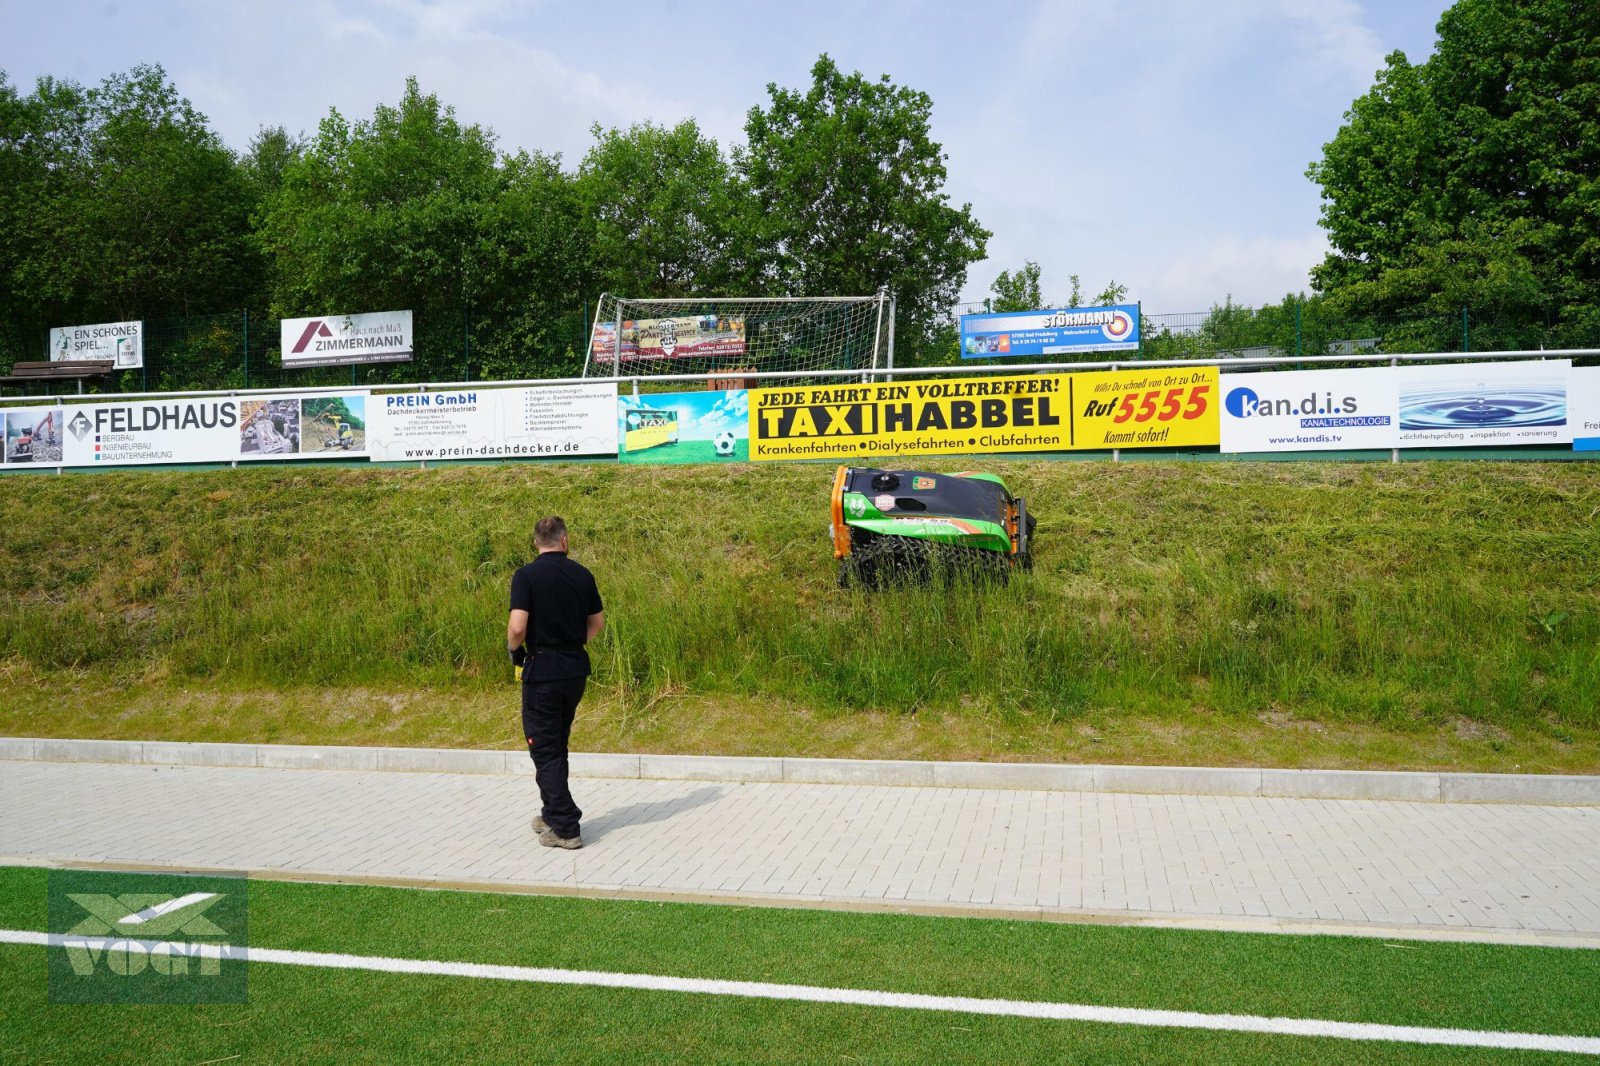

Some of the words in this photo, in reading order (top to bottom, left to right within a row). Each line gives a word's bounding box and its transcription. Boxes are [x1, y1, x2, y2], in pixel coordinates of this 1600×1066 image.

[1042, 310, 1115, 328] STÖRMANN
[74, 329, 90, 340] EIN
[93, 325, 138, 339] SCHÖNES
[351, 326, 367, 335] Haus
[369, 325, 384, 334] nach
[386, 323, 401, 333] Maß
[74, 340, 109, 351] SPIEL...
[315, 335, 403, 351] ZIMMERMANN
[1112, 383, 1122, 391] Du
[1122, 378, 1148, 390] schnell
[1148, 380, 1161, 388] von
[1164, 376, 1177, 386] Ort
[1178, 377, 1188, 385] zu
[758, 392, 806, 406] JEDE
[811, 388, 871, 403] FAHRT
[876, 386, 910, 400] EIN
[916, 378, 1060, 398] VOLLTREFFER!
[386, 396, 430, 407] PREIN
[435, 393, 477, 406] GmbH
[1083, 397, 1119, 417] Ruf
[1113, 385, 1210, 424] 5555
[1241, 392, 1358, 417] kan.d.i.s
[95, 402, 237, 433] FELDHAUS
[387, 406, 477, 415] Dachdeckermeisterbetrieb
[761, 404, 874, 438] TAXI
[885, 397, 1060, 433] HABBEL
[642, 418, 667, 428] TAXI
[1301, 416, 1390, 427] KANALTECHNOLOGIE
[102, 434, 135, 442] BERGBAU
[1103, 430, 1135, 444] Kommt
[1136, 427, 1170, 442] sofort!
[1269, 434, 1342, 444] www.kandis.tv
[1473, 431, 1511, 439] inspektion
[1520, 430, 1558, 438] sanierung
[102, 442, 152, 451] INGENIEURBAU
[405, 442, 580, 457] www.prein-dachdecker.de
[757, 441, 857, 455] Krankenfahrten
[868, 437, 964, 453] Dialysefahrten
[979, 433, 1060, 447] Clubfahrten
[102, 451, 173, 460] BAUUNTERNEHMUNG
